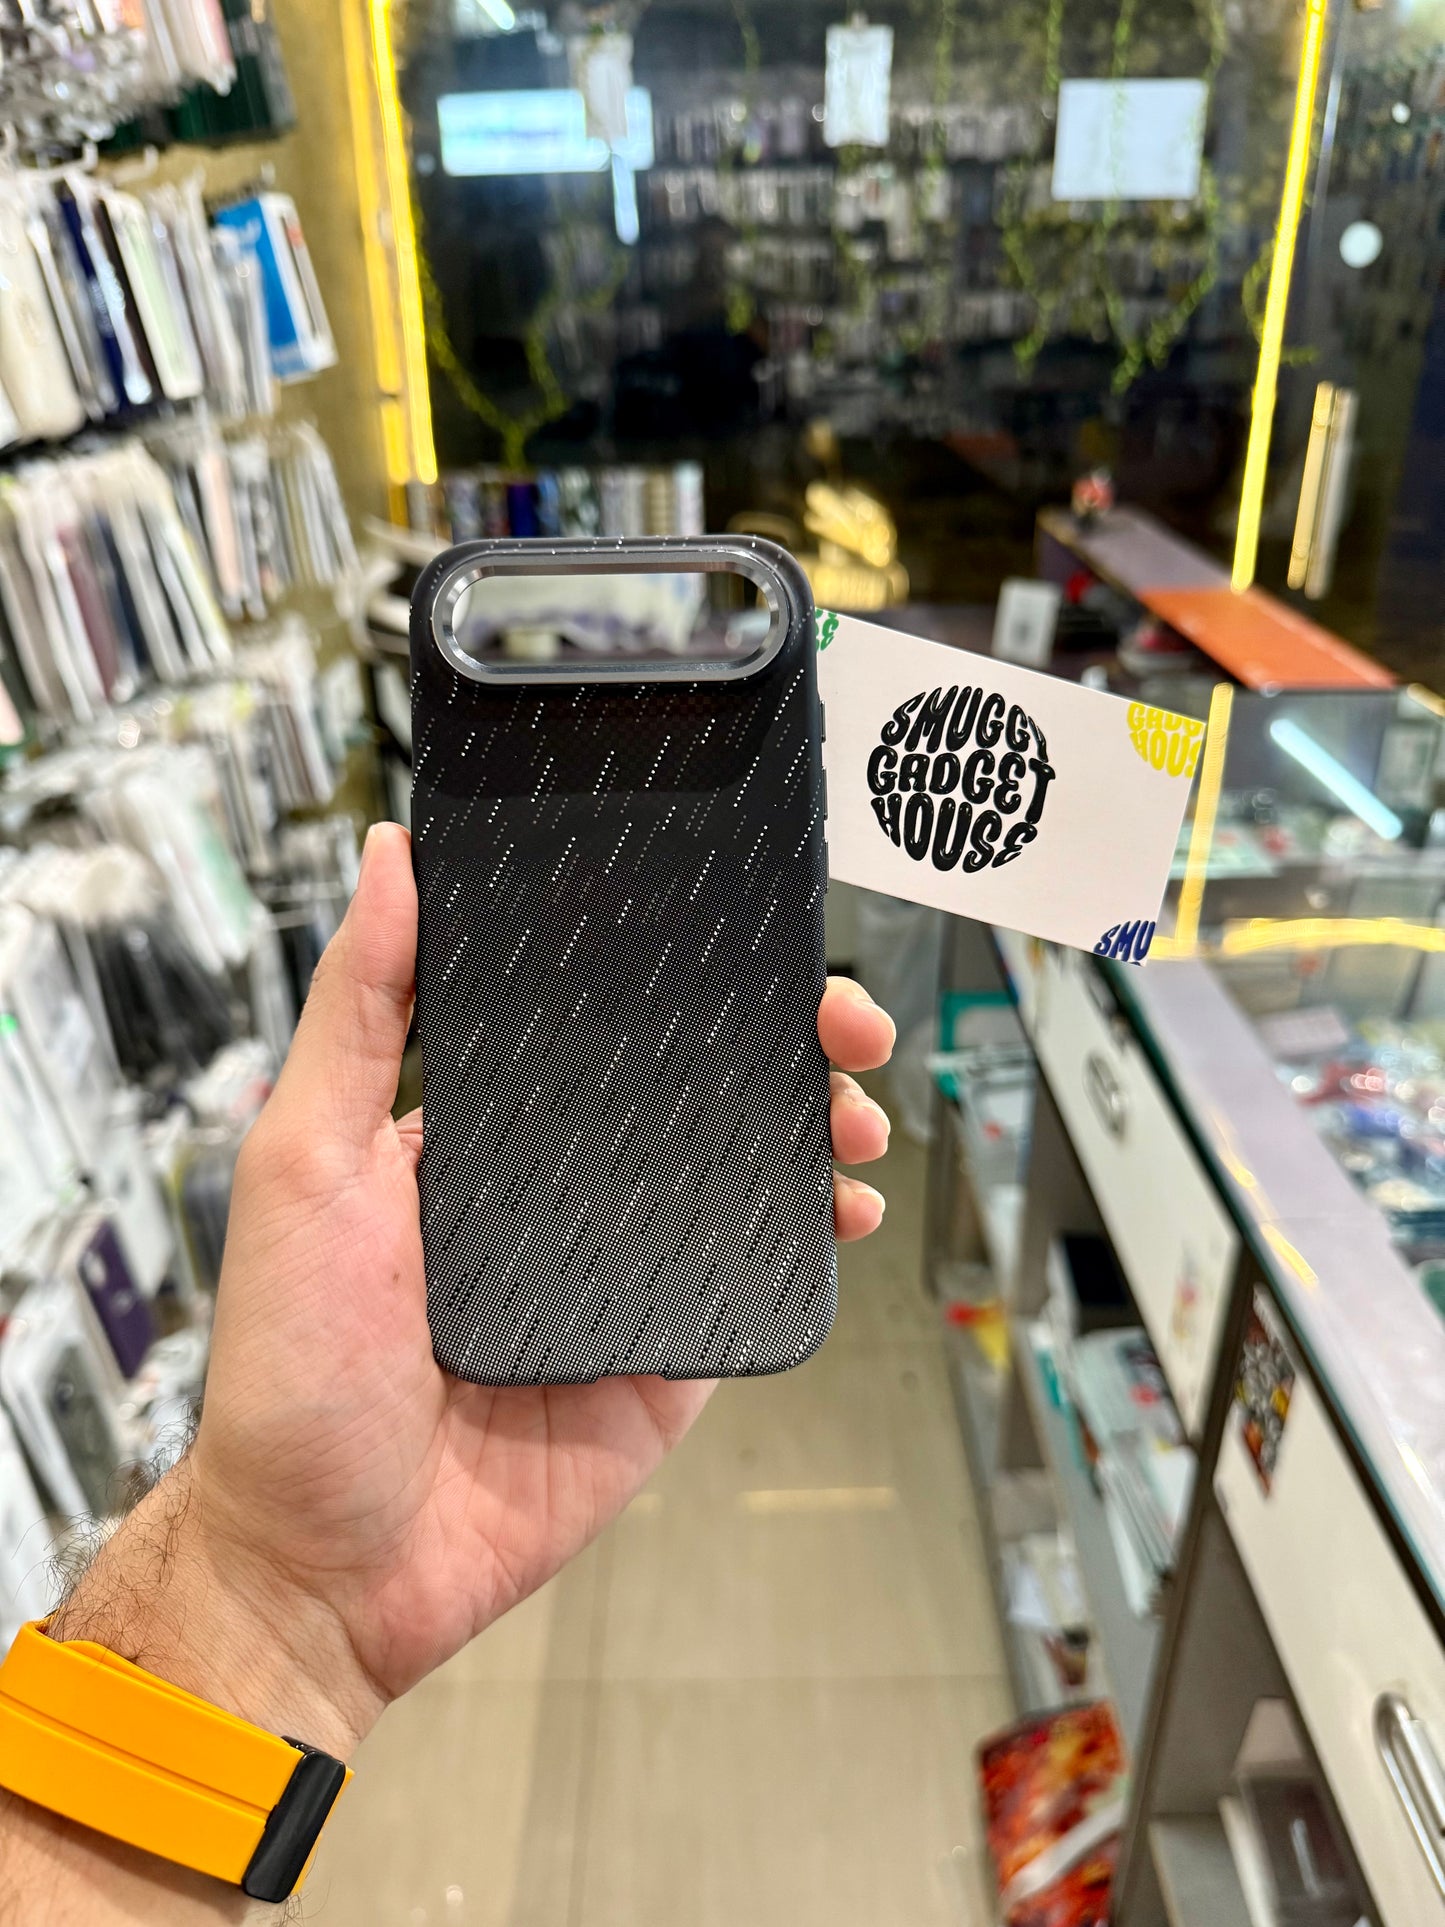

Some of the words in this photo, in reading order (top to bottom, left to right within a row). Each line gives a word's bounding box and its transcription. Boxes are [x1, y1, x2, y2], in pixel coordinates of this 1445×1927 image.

[881, 685, 1048, 762] SMUGGY
[867, 745, 1056, 824] GADGET
[871, 793, 1038, 873] HOUSE
[1093, 919, 1156, 962] SMU
